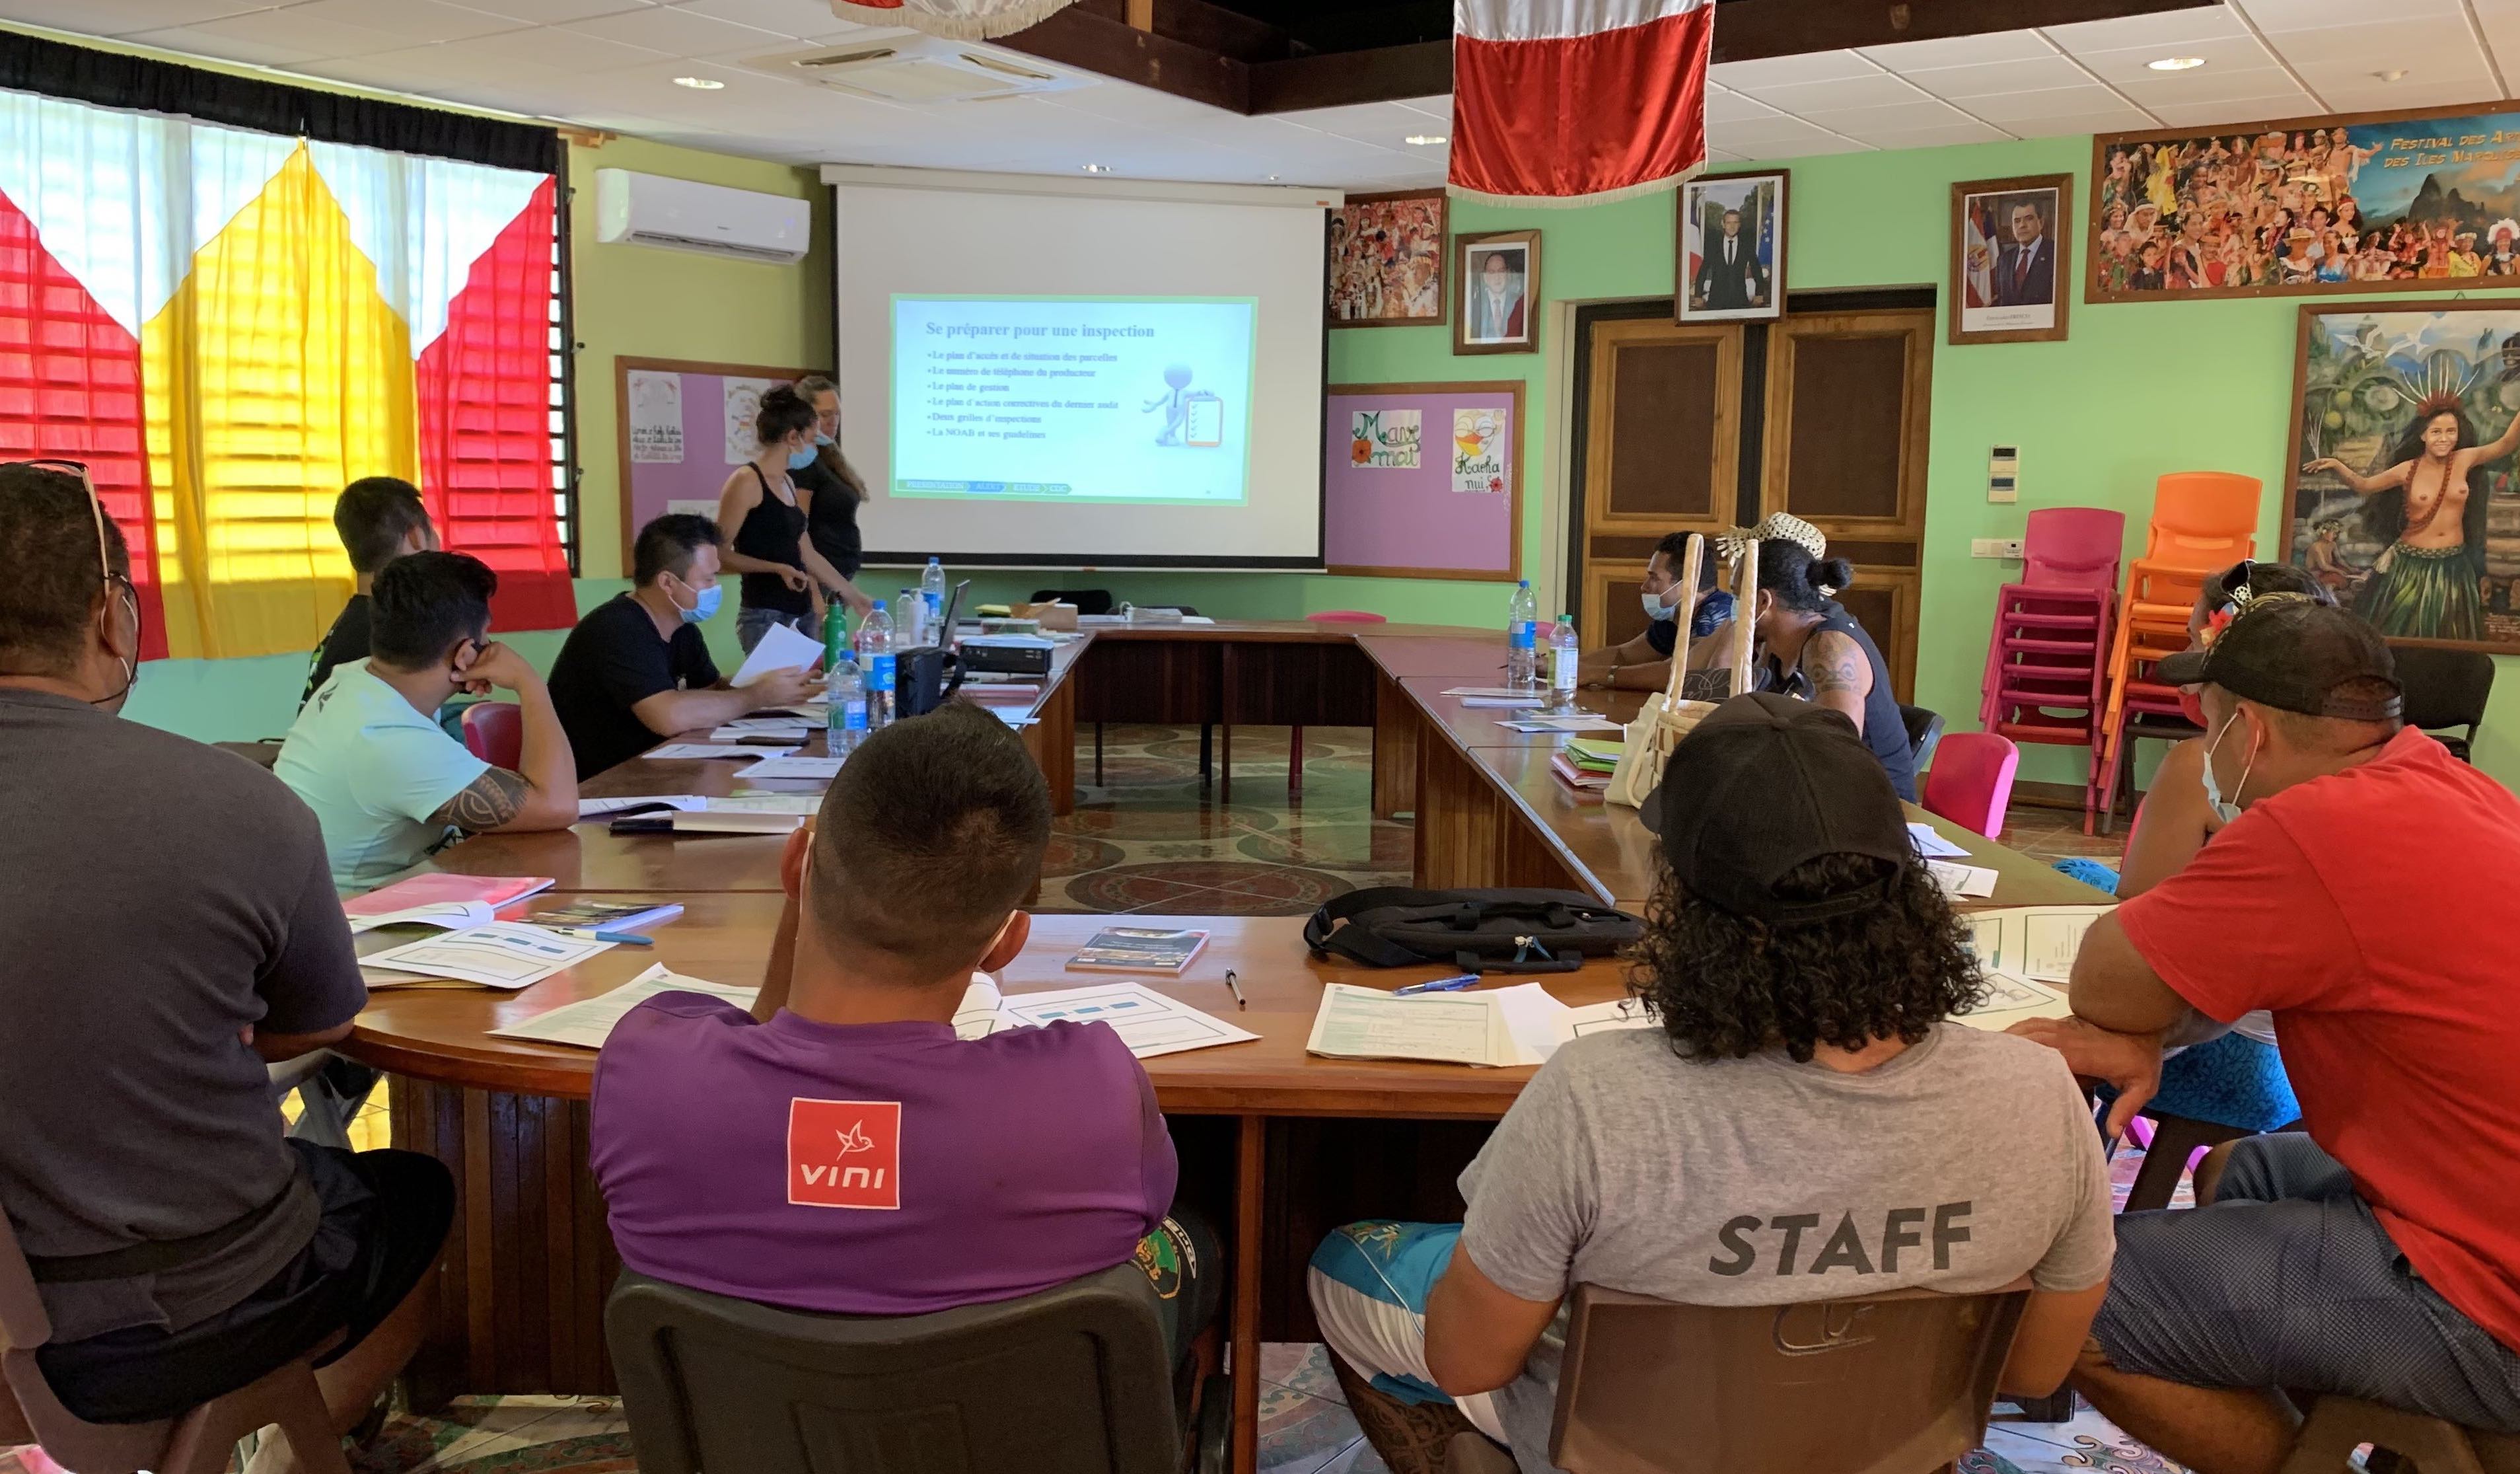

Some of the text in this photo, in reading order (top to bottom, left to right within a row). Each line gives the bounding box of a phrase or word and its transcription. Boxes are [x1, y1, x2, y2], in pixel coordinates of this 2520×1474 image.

[2391, 137, 2453, 151] FESTIVAL
[2459, 134, 2486, 146] DES
[2384, 157, 2410, 168] DES
[2415, 153, 2446, 166] ILES
[926, 322, 1155, 340] Se préparer pour une inspection
[947, 351, 964, 361] plan
[1024, 352, 1060, 361] situation
[1063, 353, 1077, 361] des
[1079, 353, 1118, 363] parcelles
[993, 368, 1034, 377] téléphone
[1050, 369, 1096, 378] producteur
[947, 383, 964, 392] plan
[980, 385, 1009, 393] gestion
[946, 398, 964, 407] plan
[957, 414, 983, 423] grilles
[1708, 1200, 1972, 1276] STAFF
